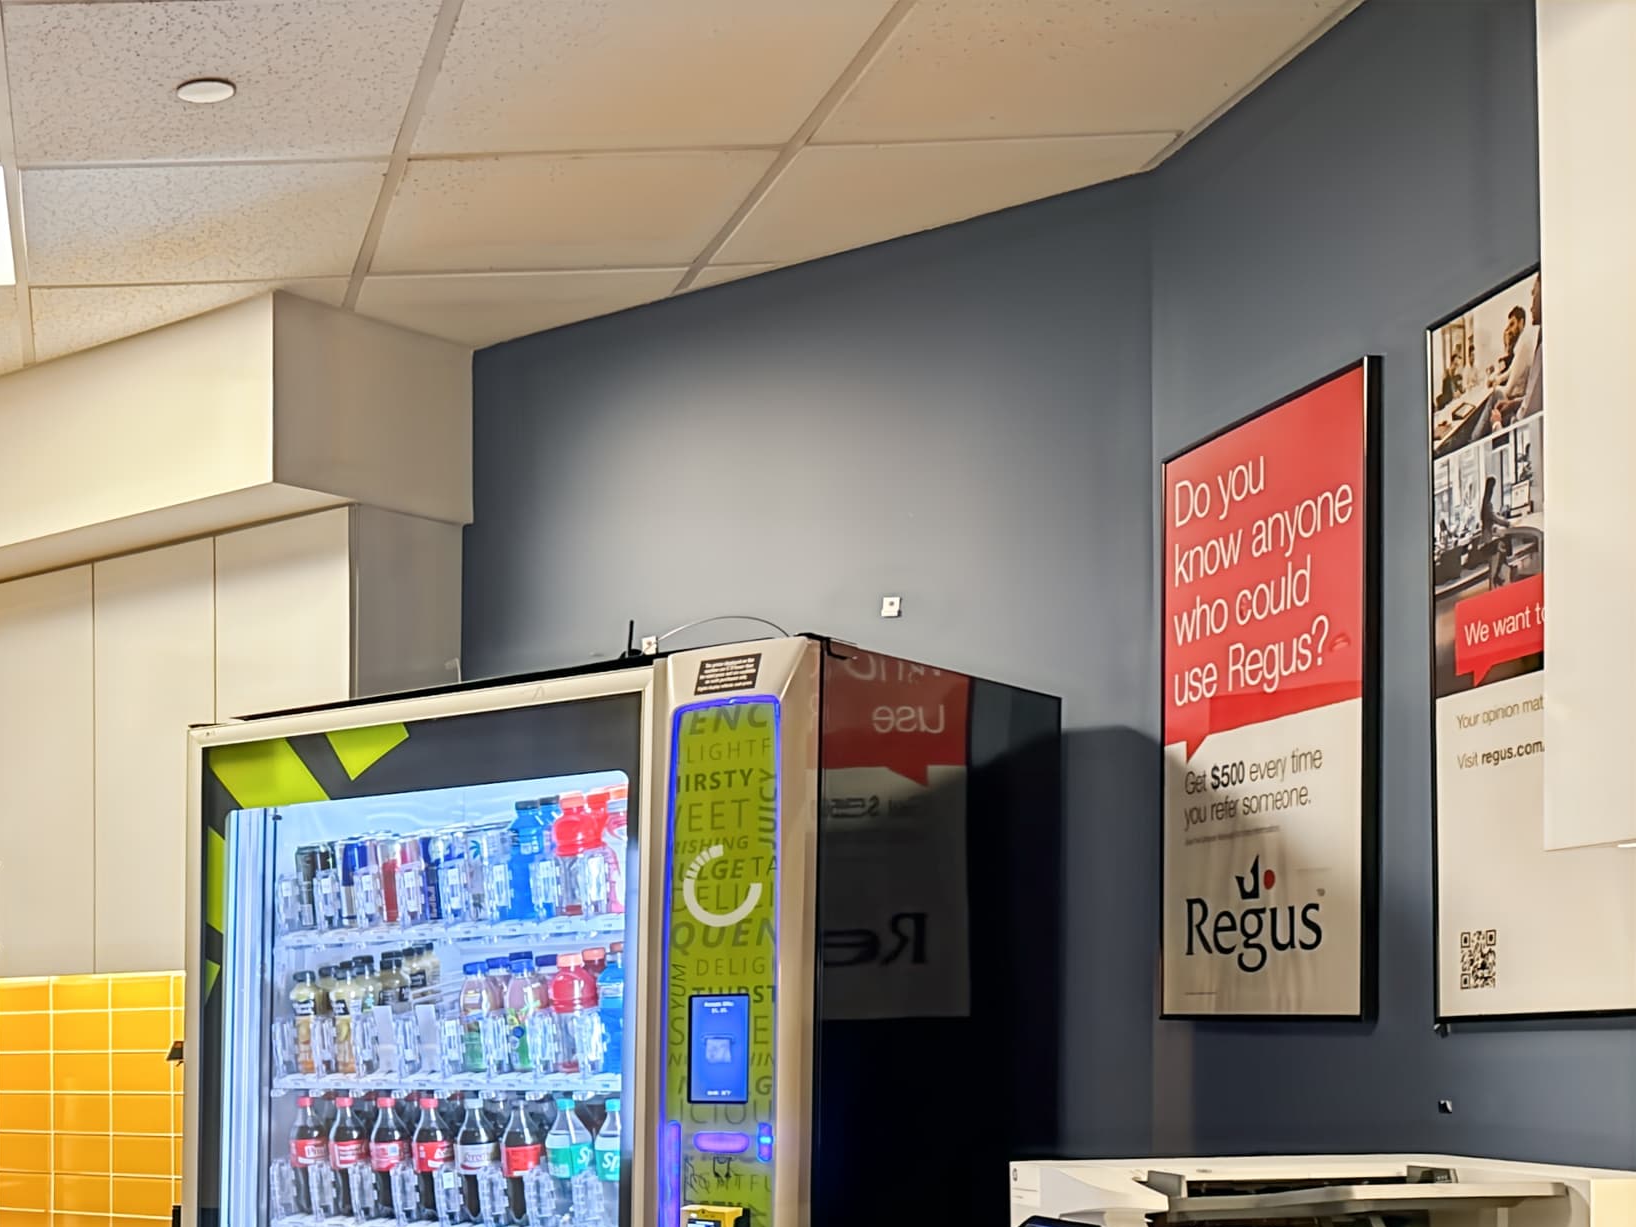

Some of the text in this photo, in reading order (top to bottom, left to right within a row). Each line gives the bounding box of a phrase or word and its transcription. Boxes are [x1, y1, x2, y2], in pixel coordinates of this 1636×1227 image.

[1174, 455, 1266, 528] Do you
[1174, 483, 1354, 588] know anyone
[1173, 554, 1311, 647] who could
[1464, 618, 1491, 647] We
[1493, 605, 1531, 641] want
[1174, 613, 1331, 707] use Regus?
[1455, 694, 1544, 731] Your opinion mat
[686, 736, 772, 765] LIGHTF
[1184, 747, 1323, 795] Get $500 every time
[1457, 750, 1479, 770] Visit
[1184, 788, 1312, 832] you refer someone.
[1184, 896, 1323, 973] Regus
[671, 963, 687, 1010] YUM
